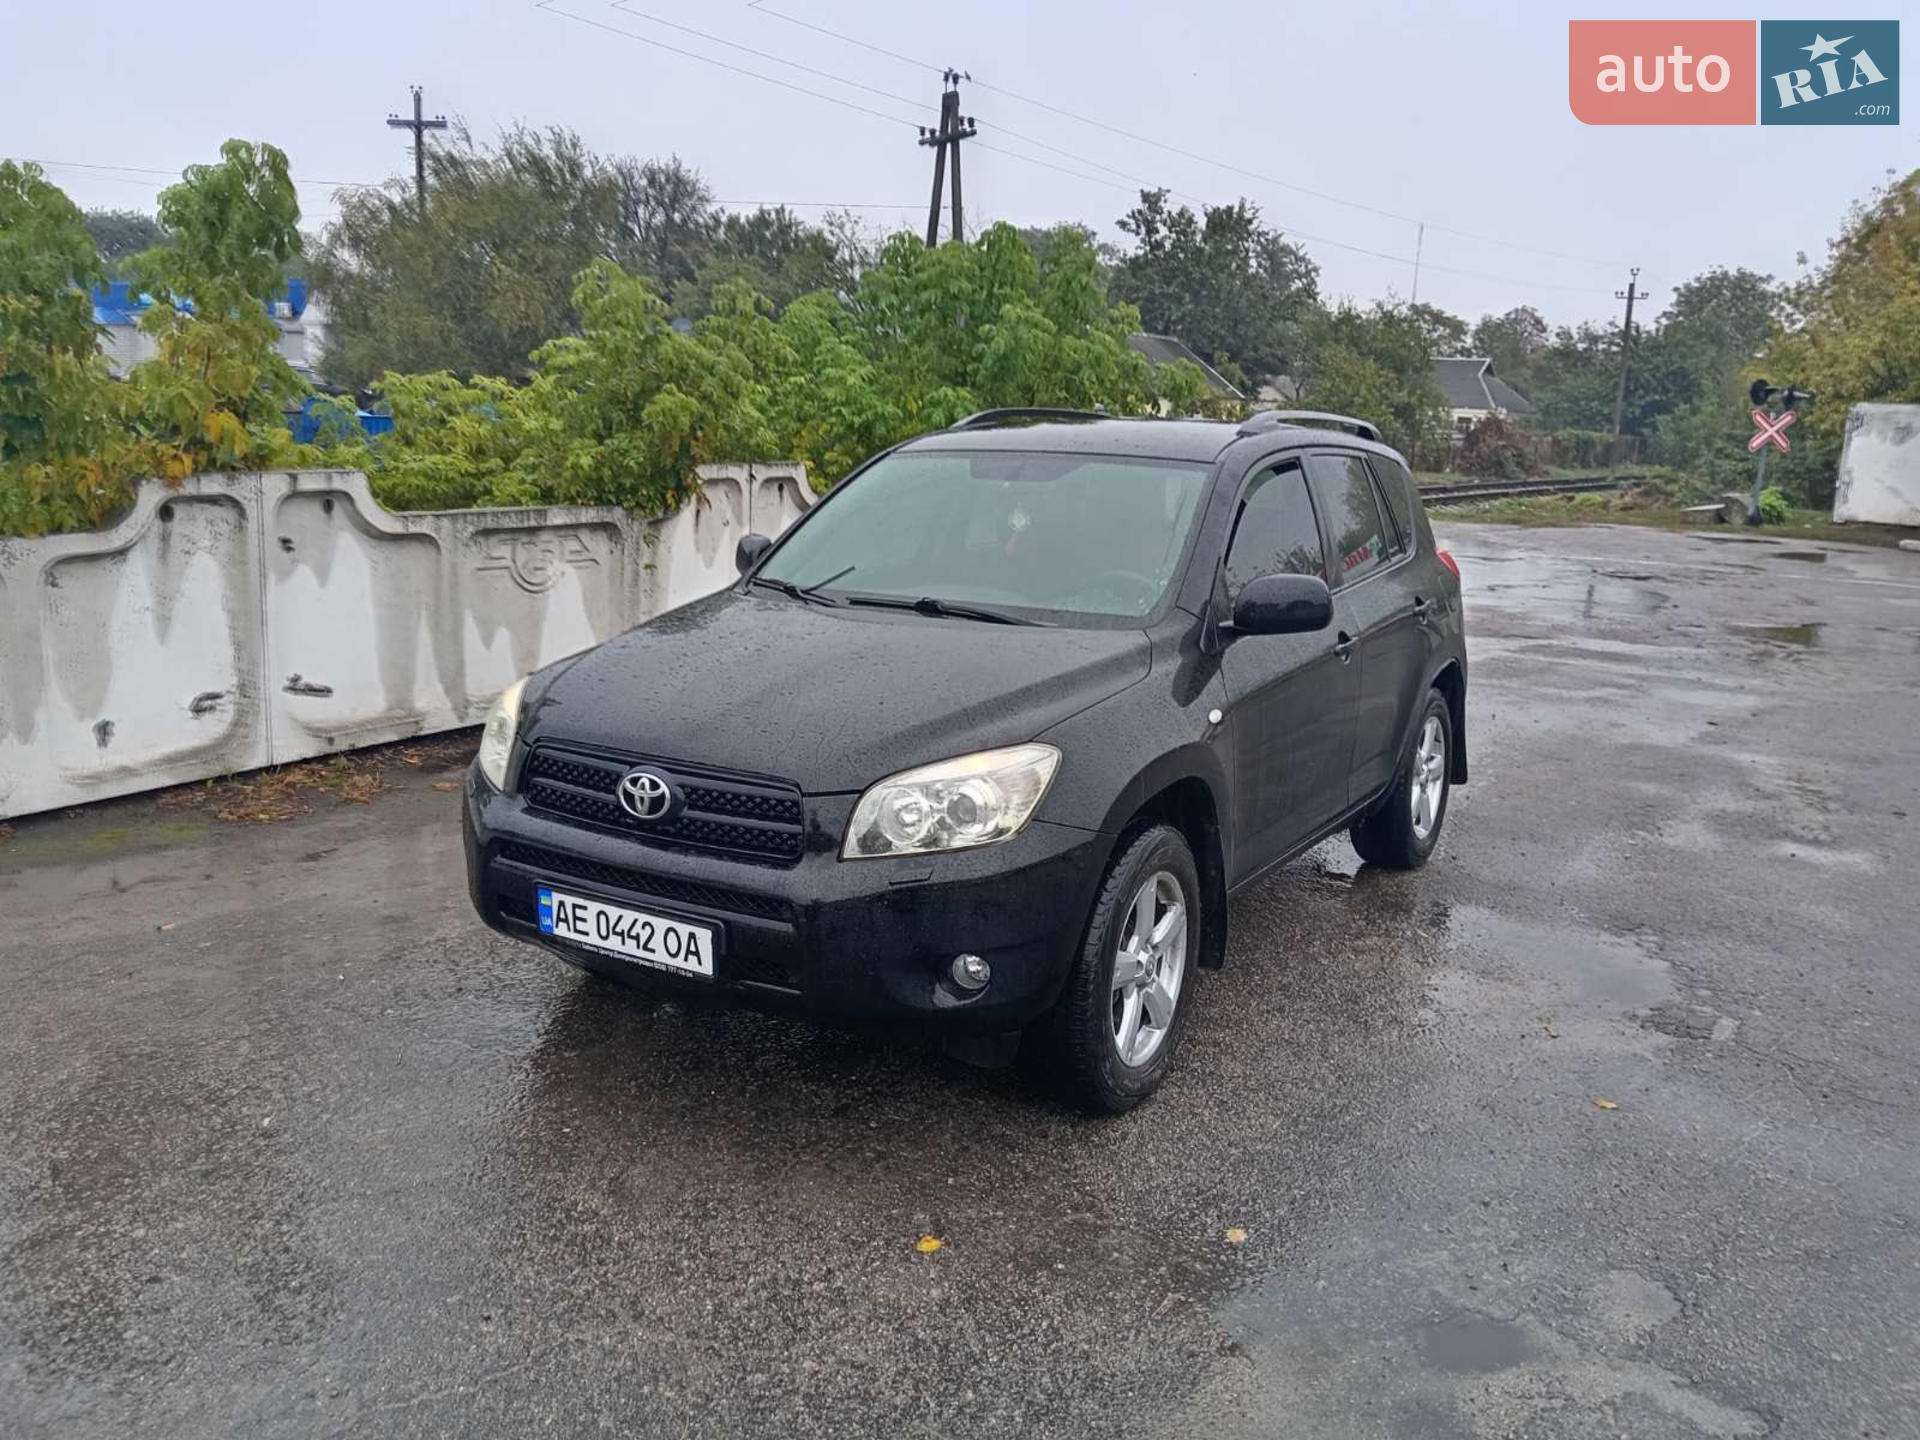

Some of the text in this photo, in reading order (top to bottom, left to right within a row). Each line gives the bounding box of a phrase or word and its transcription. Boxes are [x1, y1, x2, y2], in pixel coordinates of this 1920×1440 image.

[541, 916, 552, 926] UA
[555, 900, 590, 937] AE
[596, 910, 656, 954] 0442
[663, 926, 702, 966] OA
